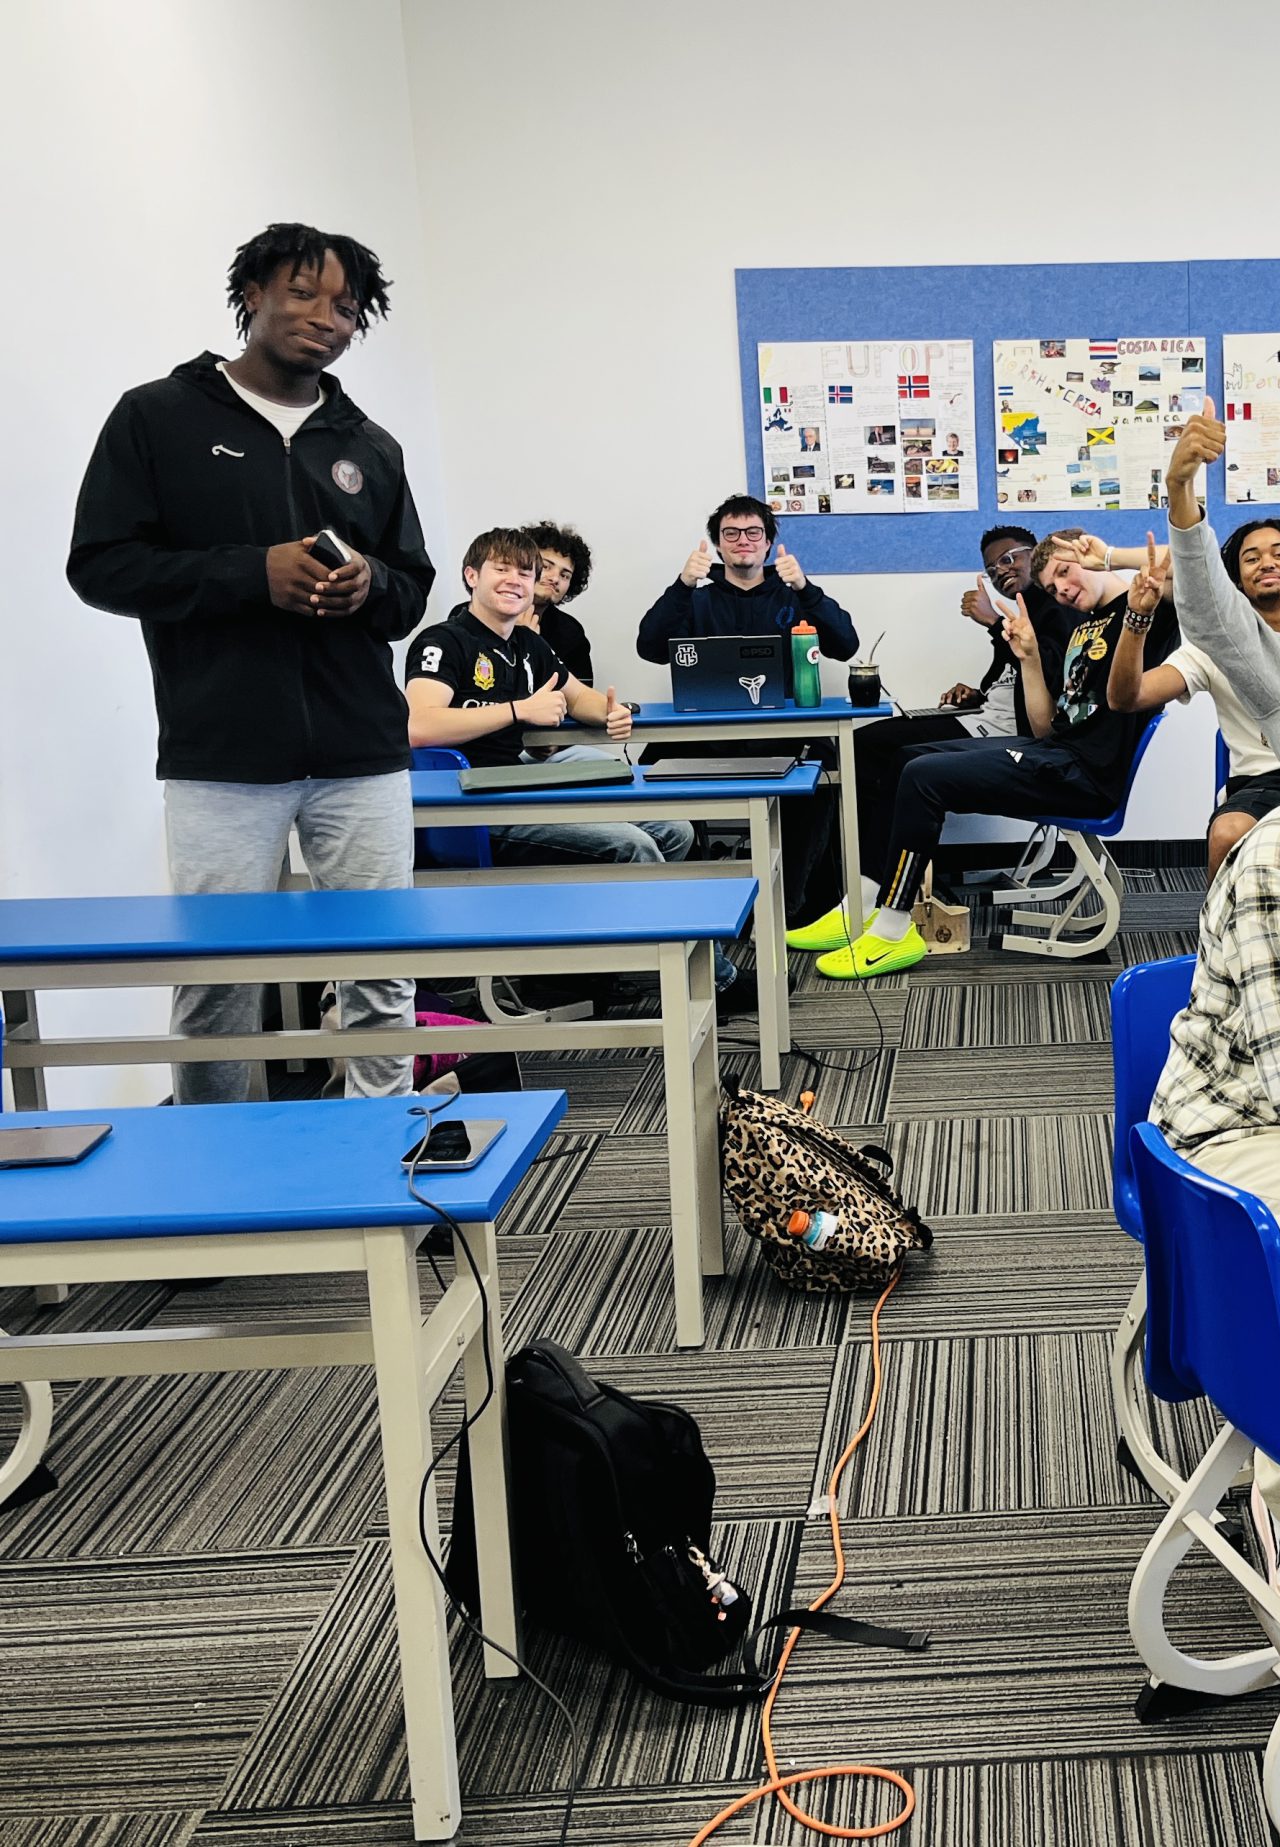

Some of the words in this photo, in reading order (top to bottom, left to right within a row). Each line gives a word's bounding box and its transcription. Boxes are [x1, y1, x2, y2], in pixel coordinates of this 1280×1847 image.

[1117, 340, 1158, 355] COSTA
[1160, 340, 1196, 353] RICA
[421, 646, 443, 673] 3
